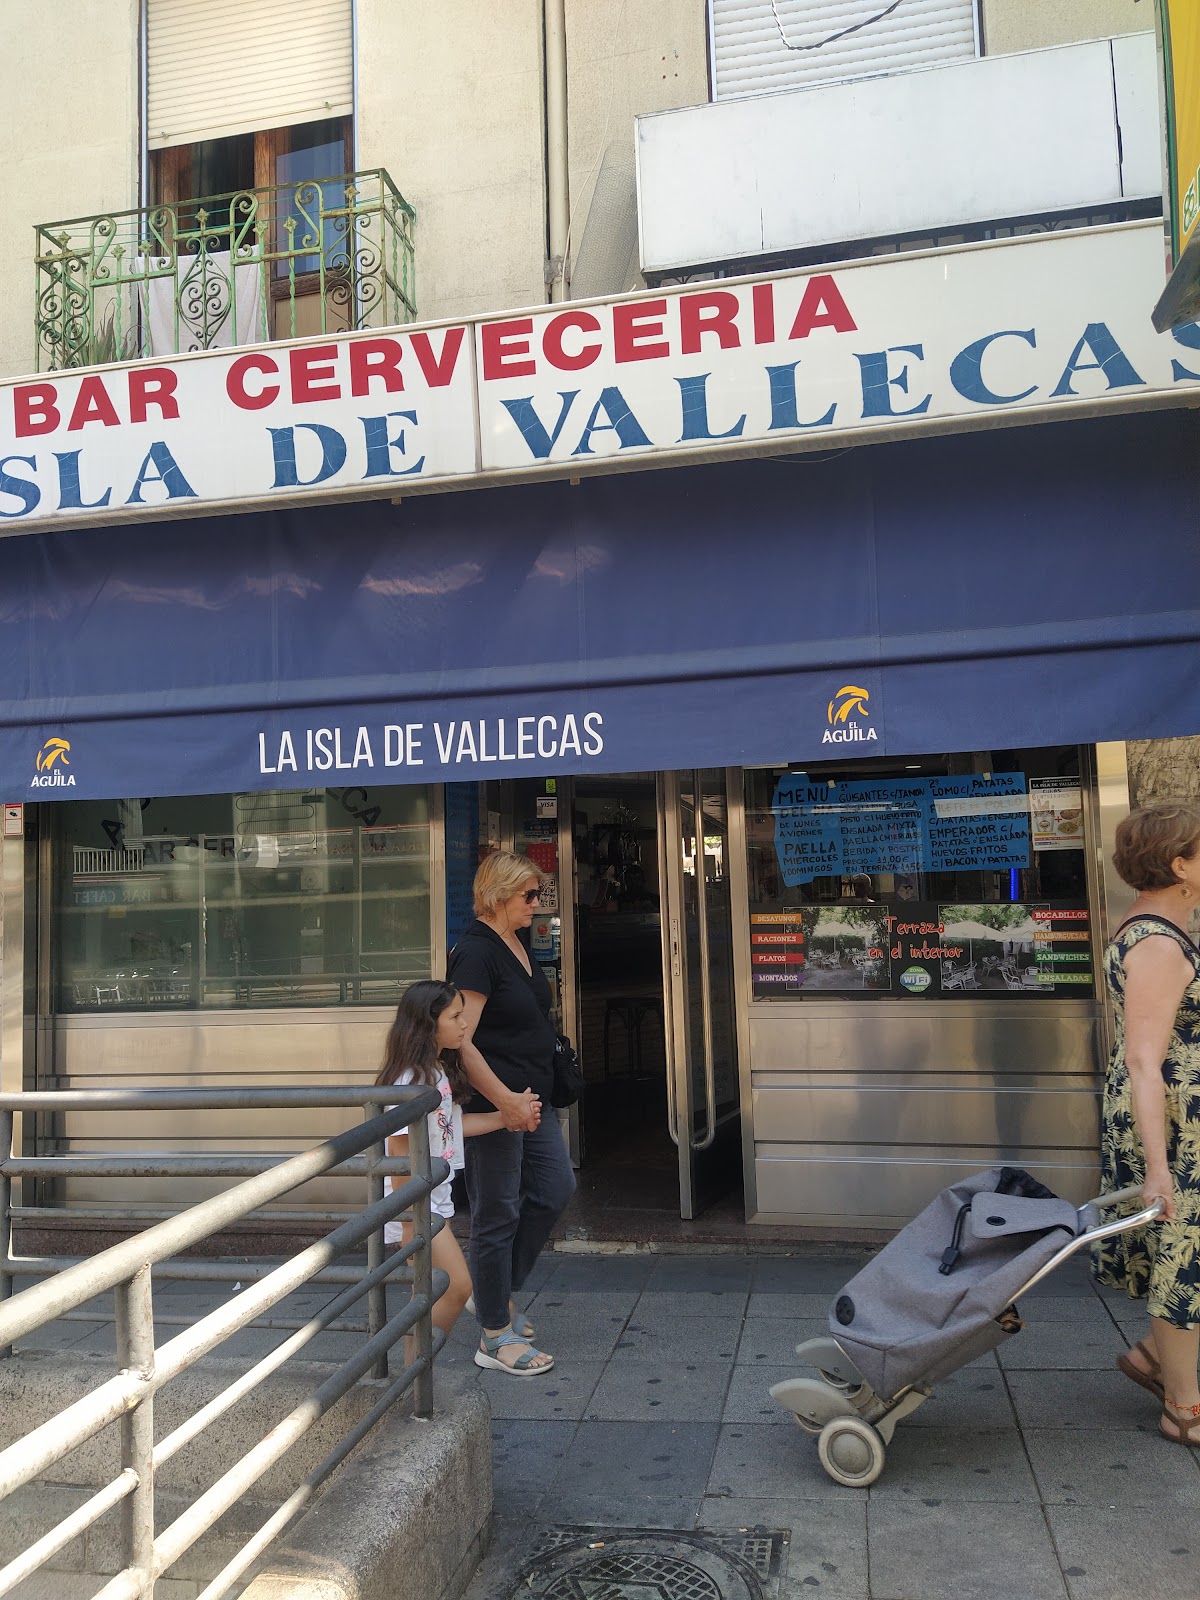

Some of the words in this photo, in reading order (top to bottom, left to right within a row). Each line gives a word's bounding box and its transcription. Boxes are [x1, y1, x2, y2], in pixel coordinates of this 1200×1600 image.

[14, 367, 180, 438] BAR
[226, 274, 858, 410] CERVECERIA
[266, 410, 426, 489] DE
[849, 721, 858, 729] EL
[822, 728, 878, 743] ÁGUILA
[258, 731, 298, 773] LA
[307, 726, 375, 771] ISLA
[384, 724, 424, 767] DE
[433, 712, 604, 764] VALLECAS
[31, 774, 76, 787] ÁGUILA
[932, 787, 960, 797] LOMO
[972, 778, 1014, 789] PATATAS
[778, 786, 829, 804] MENU
[839, 790, 889, 803] GUISANTES
[793, 819, 821, 828] LUNES
[840, 815, 860, 823] PISTO
[841, 825, 883, 835] ENSALADA
[887, 821, 917, 831] MIXTA
[929, 825, 996, 839] EMPERADOR
[932, 839, 970, 848] PATATAS
[979, 831, 1028, 843] ENSALADA
[784, 841, 837, 854] PAELLA
[843, 847, 877, 856] BEBIDA
[971, 845, 1008, 854] FRITOS
[783, 854, 838, 865] MIERCOLES
[988, 855, 1027, 864] PATATAS
[788, 864, 833, 876] DOMINGOS
[1035, 911, 1088, 919] BOCADILLOS
[883, 916, 945, 934] Terraza
[1035, 932, 1088, 940] HAMBURGUESAS
[869, 947, 884, 959] en
[891, 941, 902, 959] el
[910, 940, 963, 960] interior
[1036, 953, 1090, 961] SANDWICHES
